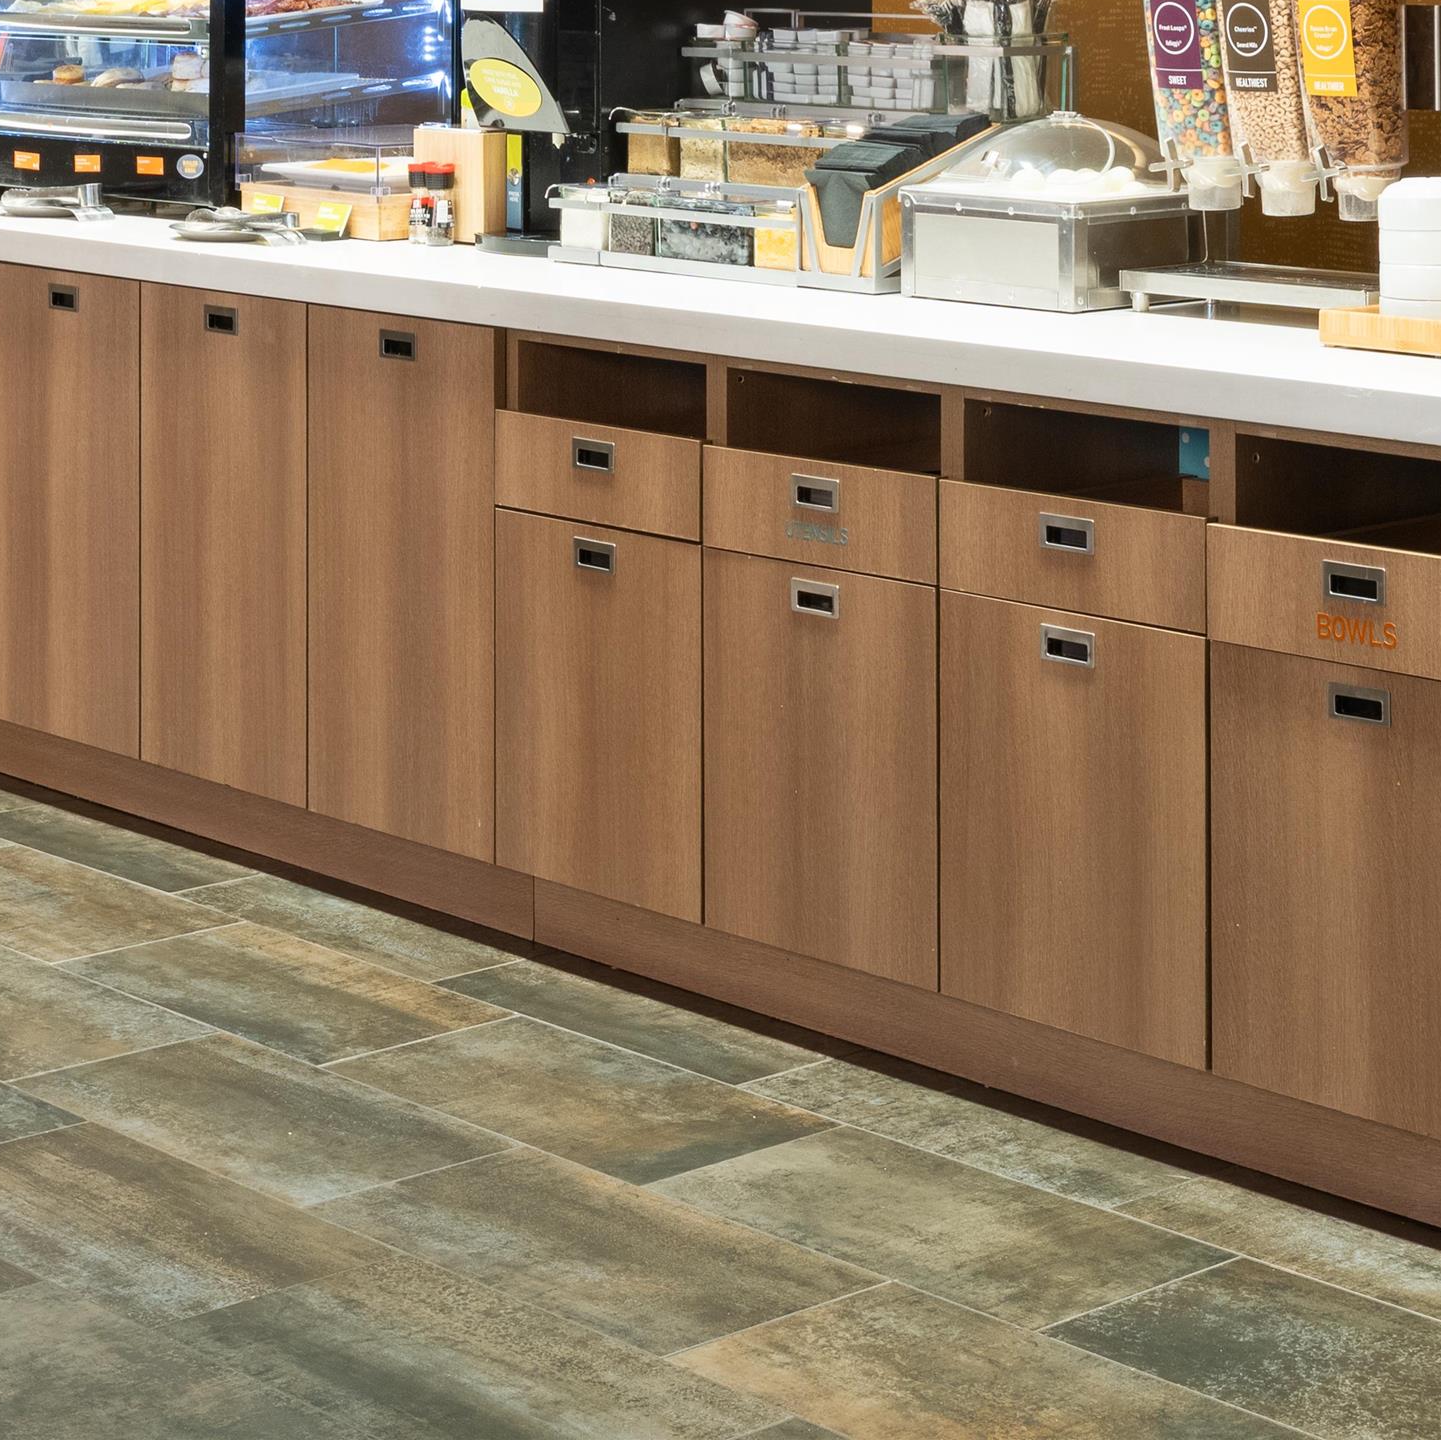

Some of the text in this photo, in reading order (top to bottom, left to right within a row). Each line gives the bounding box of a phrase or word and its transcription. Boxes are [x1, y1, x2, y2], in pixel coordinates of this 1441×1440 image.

[1168, 75, 1187, 85] SWEET
[1235, 77, 1268, 88] HEALTHIEST
[1316, 611, 1397, 649] BOWLS
